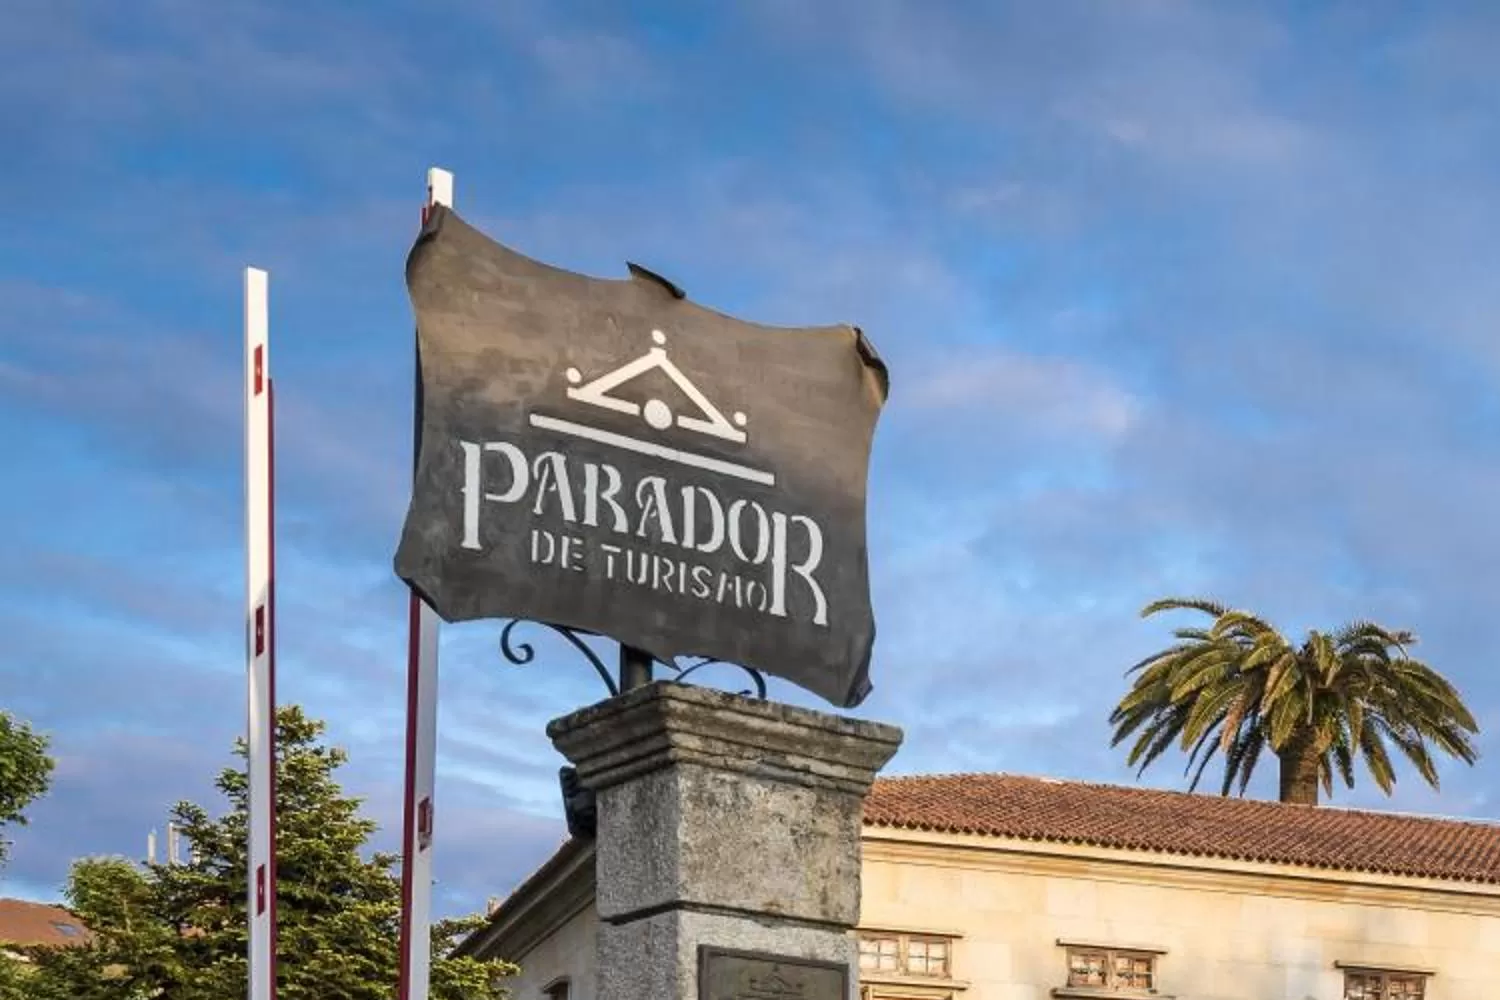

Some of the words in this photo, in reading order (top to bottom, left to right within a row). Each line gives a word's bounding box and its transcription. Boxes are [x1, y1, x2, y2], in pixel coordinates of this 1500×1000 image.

[459, 440, 828, 627] PARADOR
[530, 529, 585, 570] DE
[601, 543, 769, 612] TURISMO
